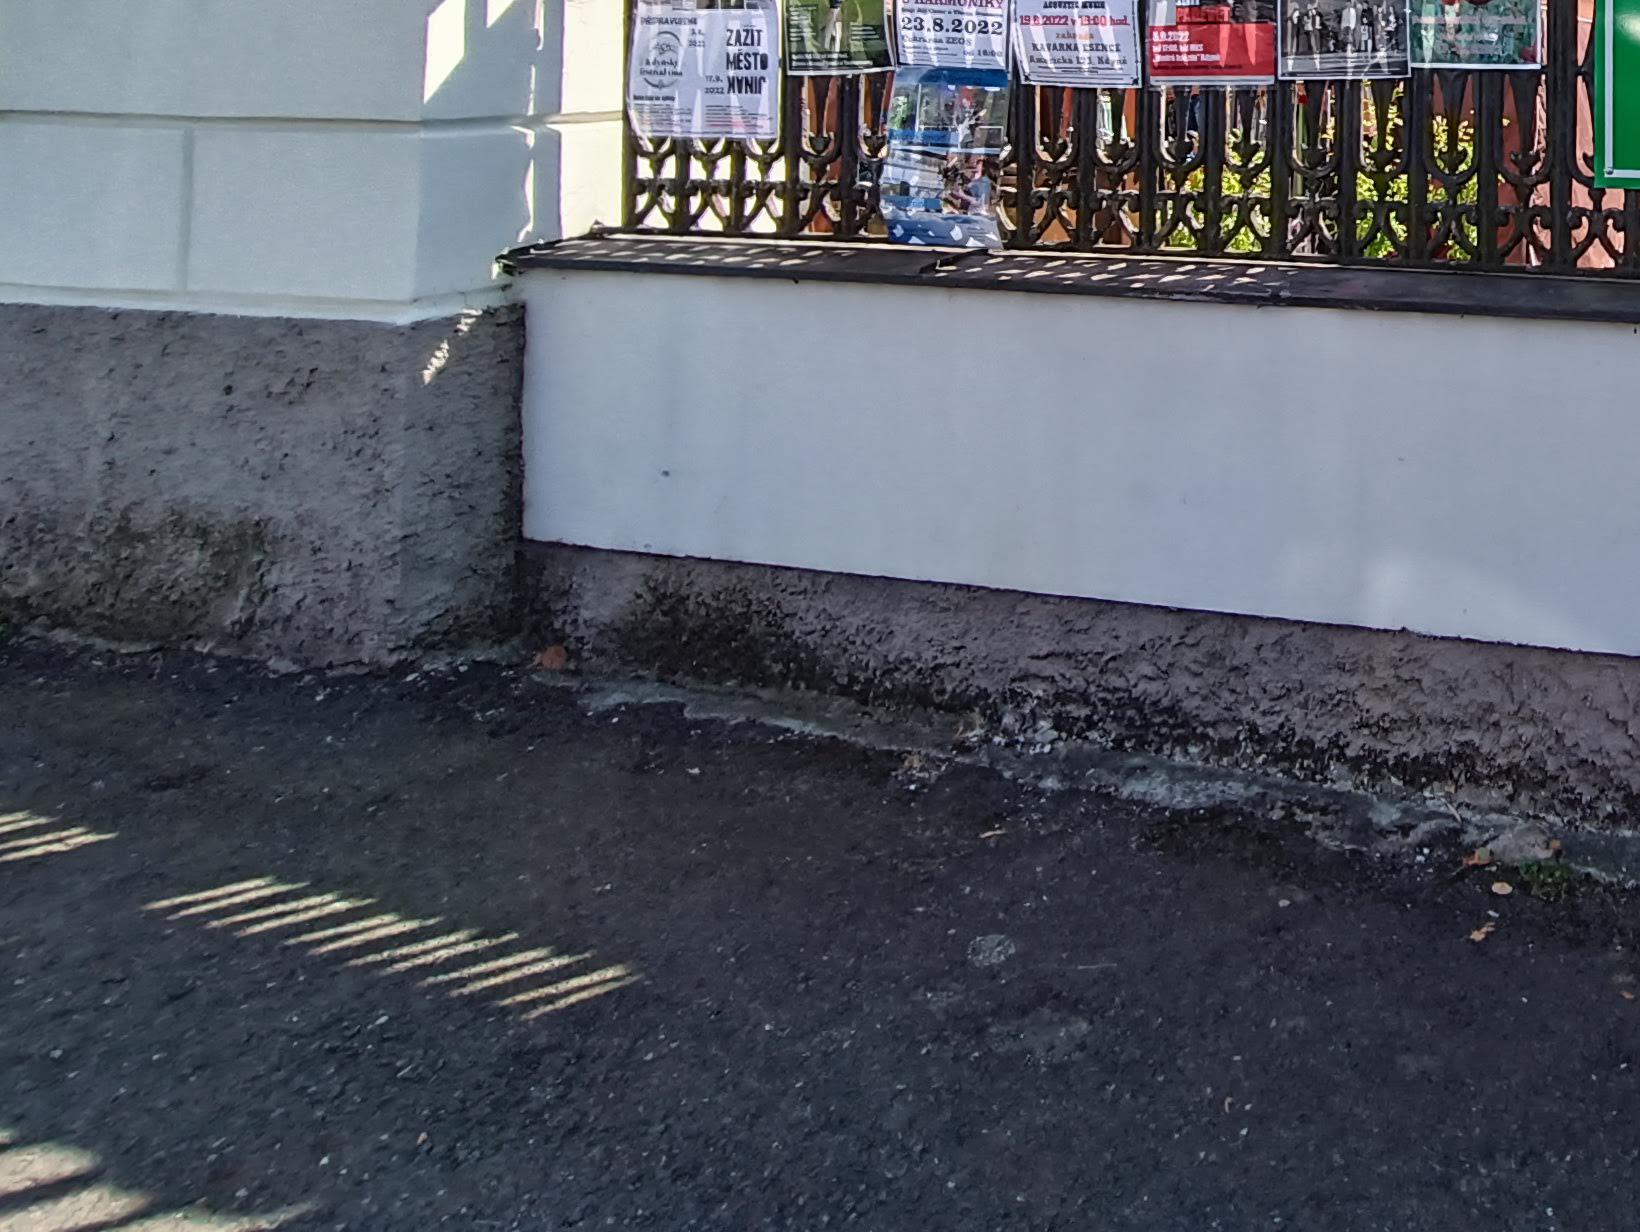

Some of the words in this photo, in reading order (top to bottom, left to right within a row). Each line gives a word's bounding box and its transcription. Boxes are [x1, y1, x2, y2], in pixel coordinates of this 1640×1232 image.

[726, 25, 763, 47] ZAŽÍT
[901, 16, 1003, 35] 23.8.2022
[726, 49, 768, 70] MĚSTO
